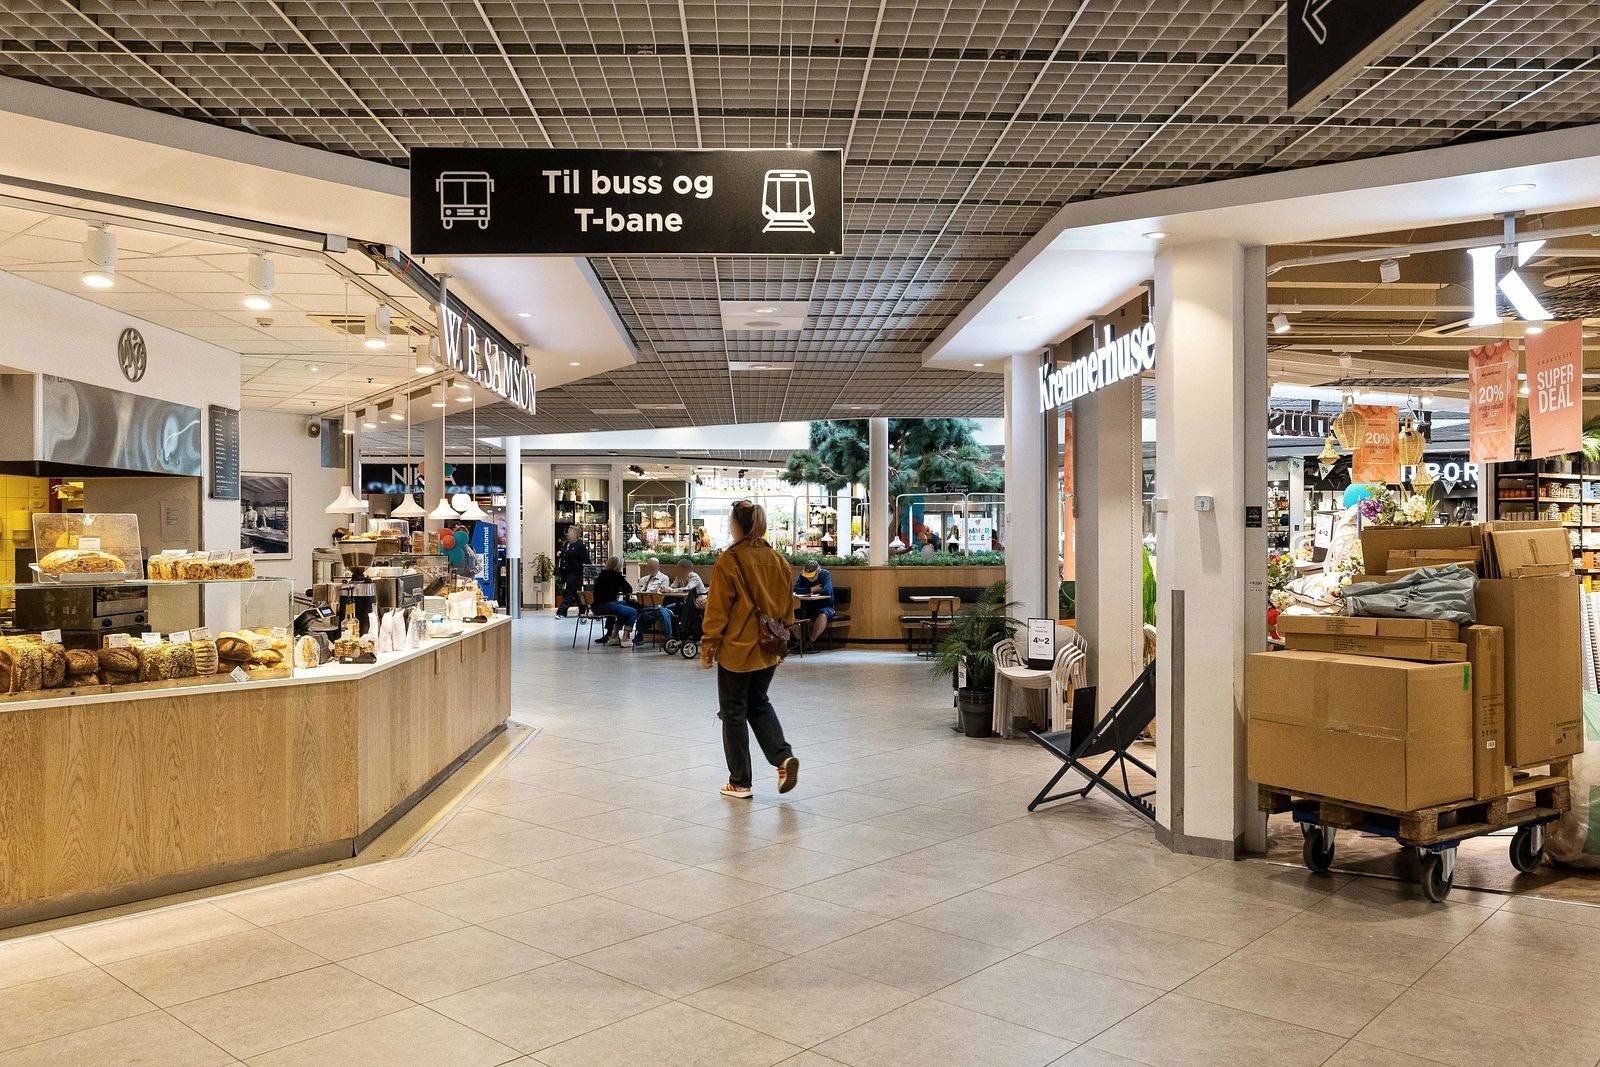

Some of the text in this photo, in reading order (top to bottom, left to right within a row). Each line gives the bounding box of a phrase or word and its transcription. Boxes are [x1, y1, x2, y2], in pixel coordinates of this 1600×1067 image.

[542, 170, 714, 199] Til buss og
[574, 208, 683, 232] T-bane
[1467, 240, 1554, 327] K
[441, 303, 536, 415] W. B. SAMSON
[1039, 322, 1156, 413] Kremmerhuse
[1537, 363, 1574, 391] SUPER
[1478, 384, 1504, 404] 20%
[1538, 384, 1574, 414] DEAL
[1365, 432, 1390, 445] 20%
[1044, 637, 1050, 645] 2
